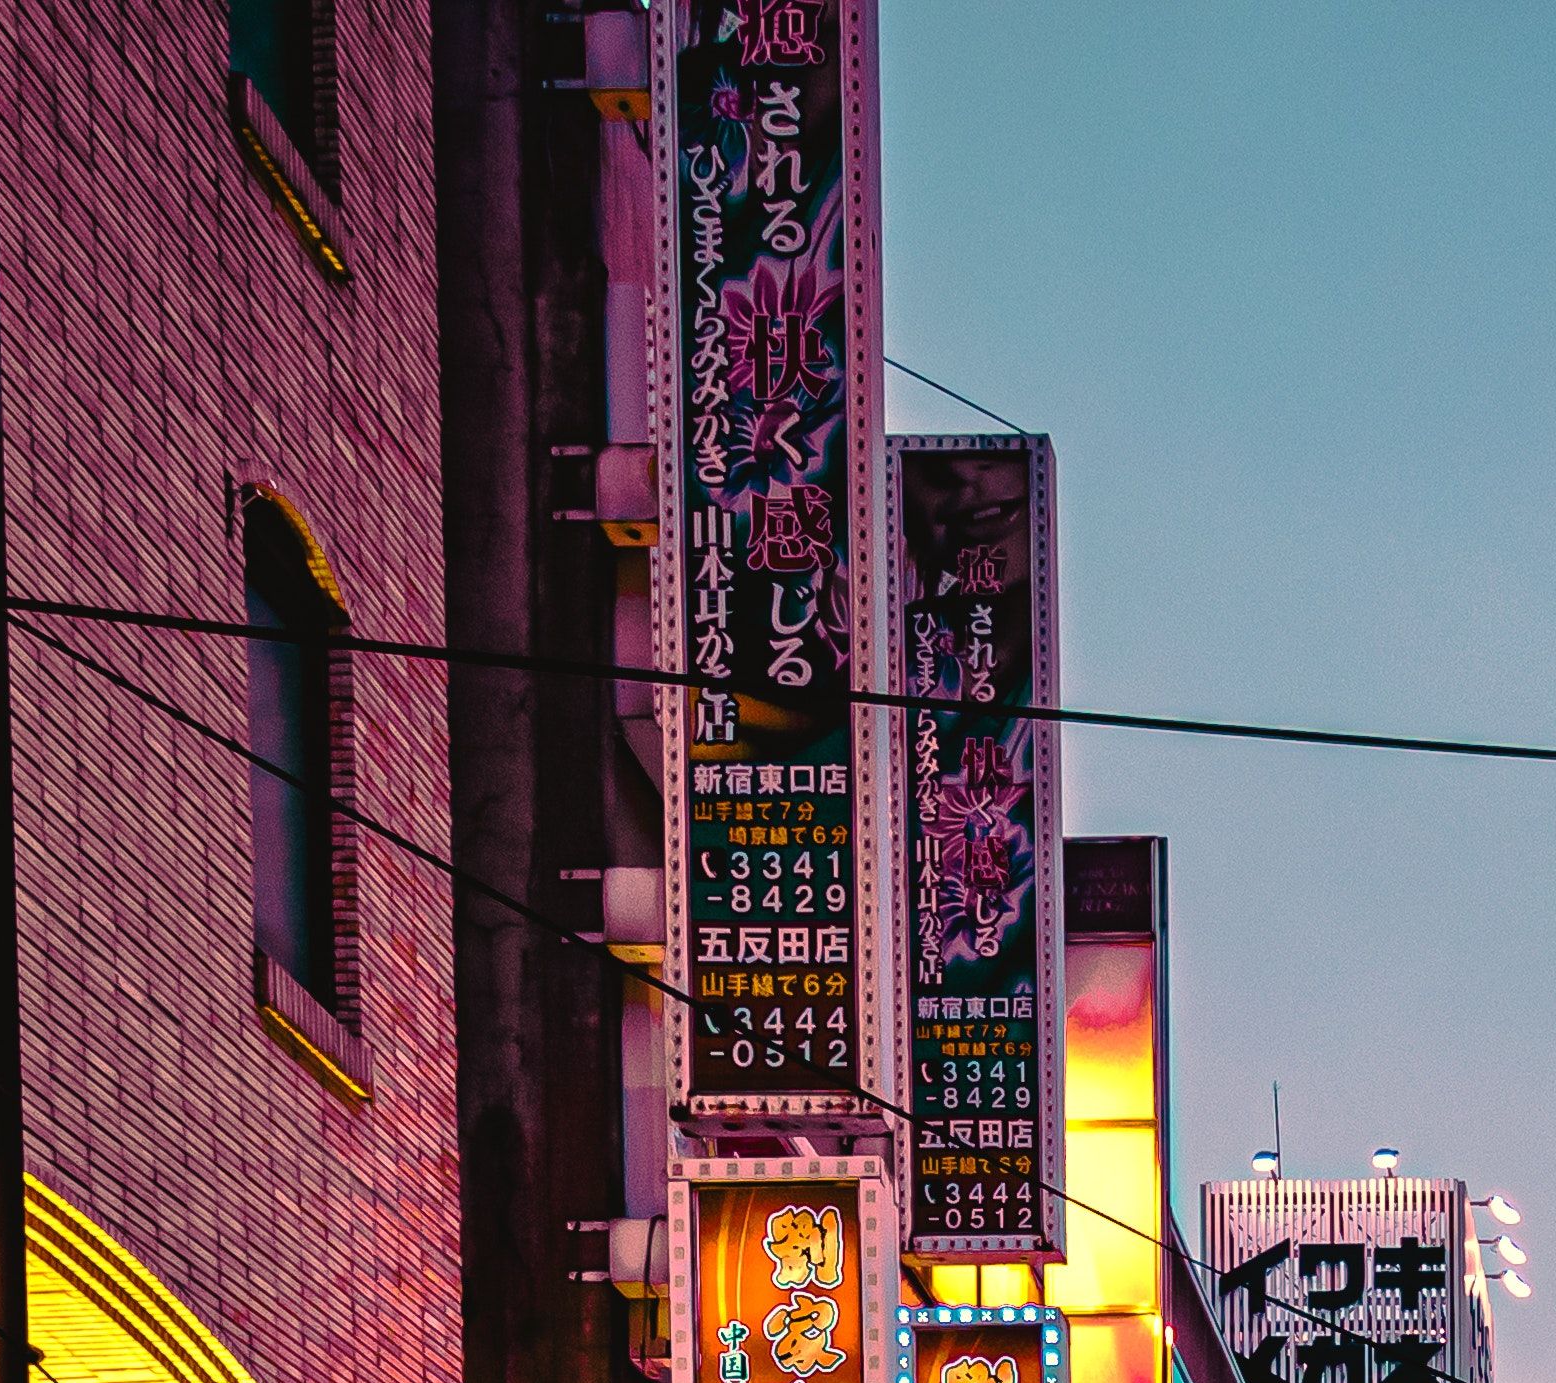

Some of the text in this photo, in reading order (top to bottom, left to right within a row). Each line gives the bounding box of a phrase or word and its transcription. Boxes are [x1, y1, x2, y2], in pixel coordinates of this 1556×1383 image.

[741, 0, 835, 689] 癒される 快く感じる
[690, 505, 736, 743] 山本耳かき店
[693, 764, 848, 795] 新宿東口店
[962, 737, 1011, 958] 快く感じる
[730, 851, 843, 879] 3341
[916, 838, 944, 986] 山本耳かき店
[697, 926, 849, 964] 五反田店
[734, 1007, 847, 1035] 3444
[917, 996, 1033, 1020] 新宿東口店
[942, 1061, 1029, 1084] 3341
[919, 1119, 1034, 1149] 五反田店
[945, 1182, 1032, 1204] 3444
[1219, 1237, 1447, 1313] イワキ
